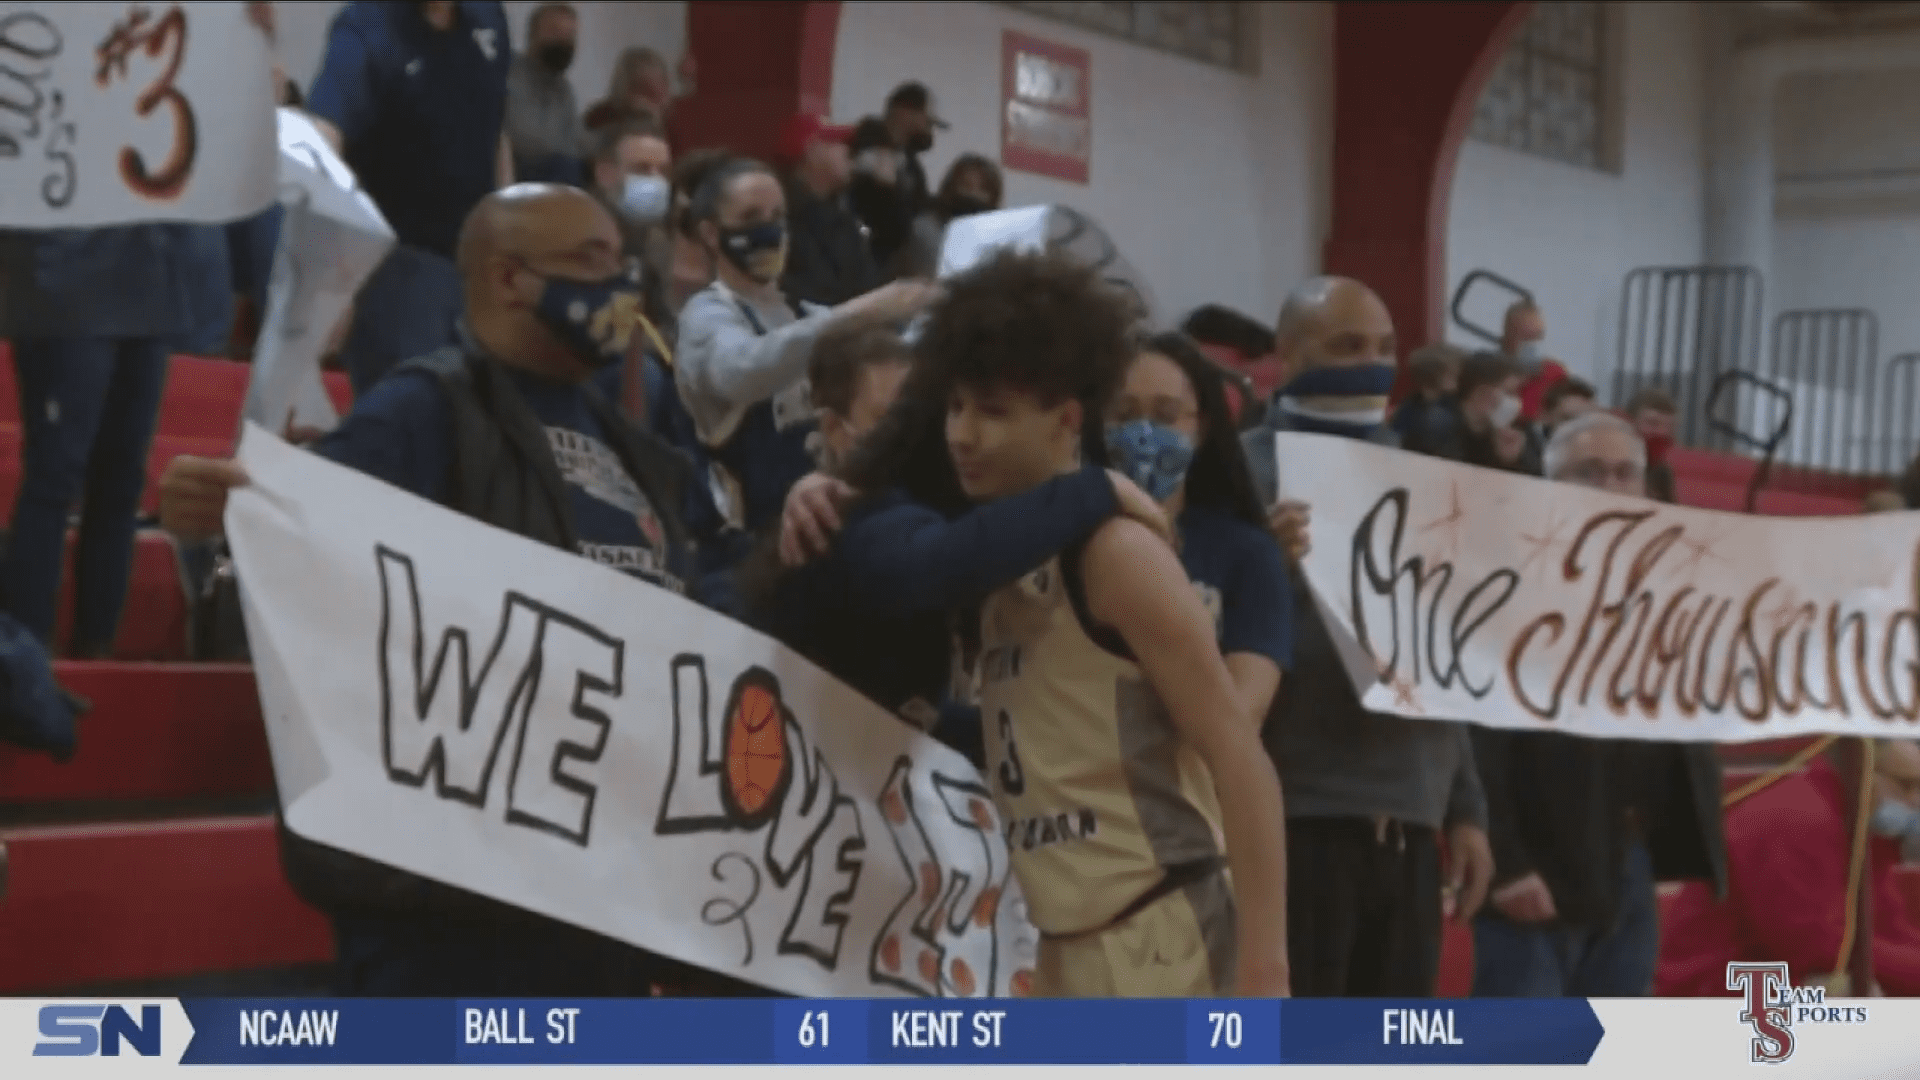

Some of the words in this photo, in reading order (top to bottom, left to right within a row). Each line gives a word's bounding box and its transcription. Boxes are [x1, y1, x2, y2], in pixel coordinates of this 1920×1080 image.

[374, 543, 625, 847] WE
[655, 653, 867, 970] LOVE
[1350, 487, 1521, 698] One
[1507, 510, 1920, 722] Thousand
